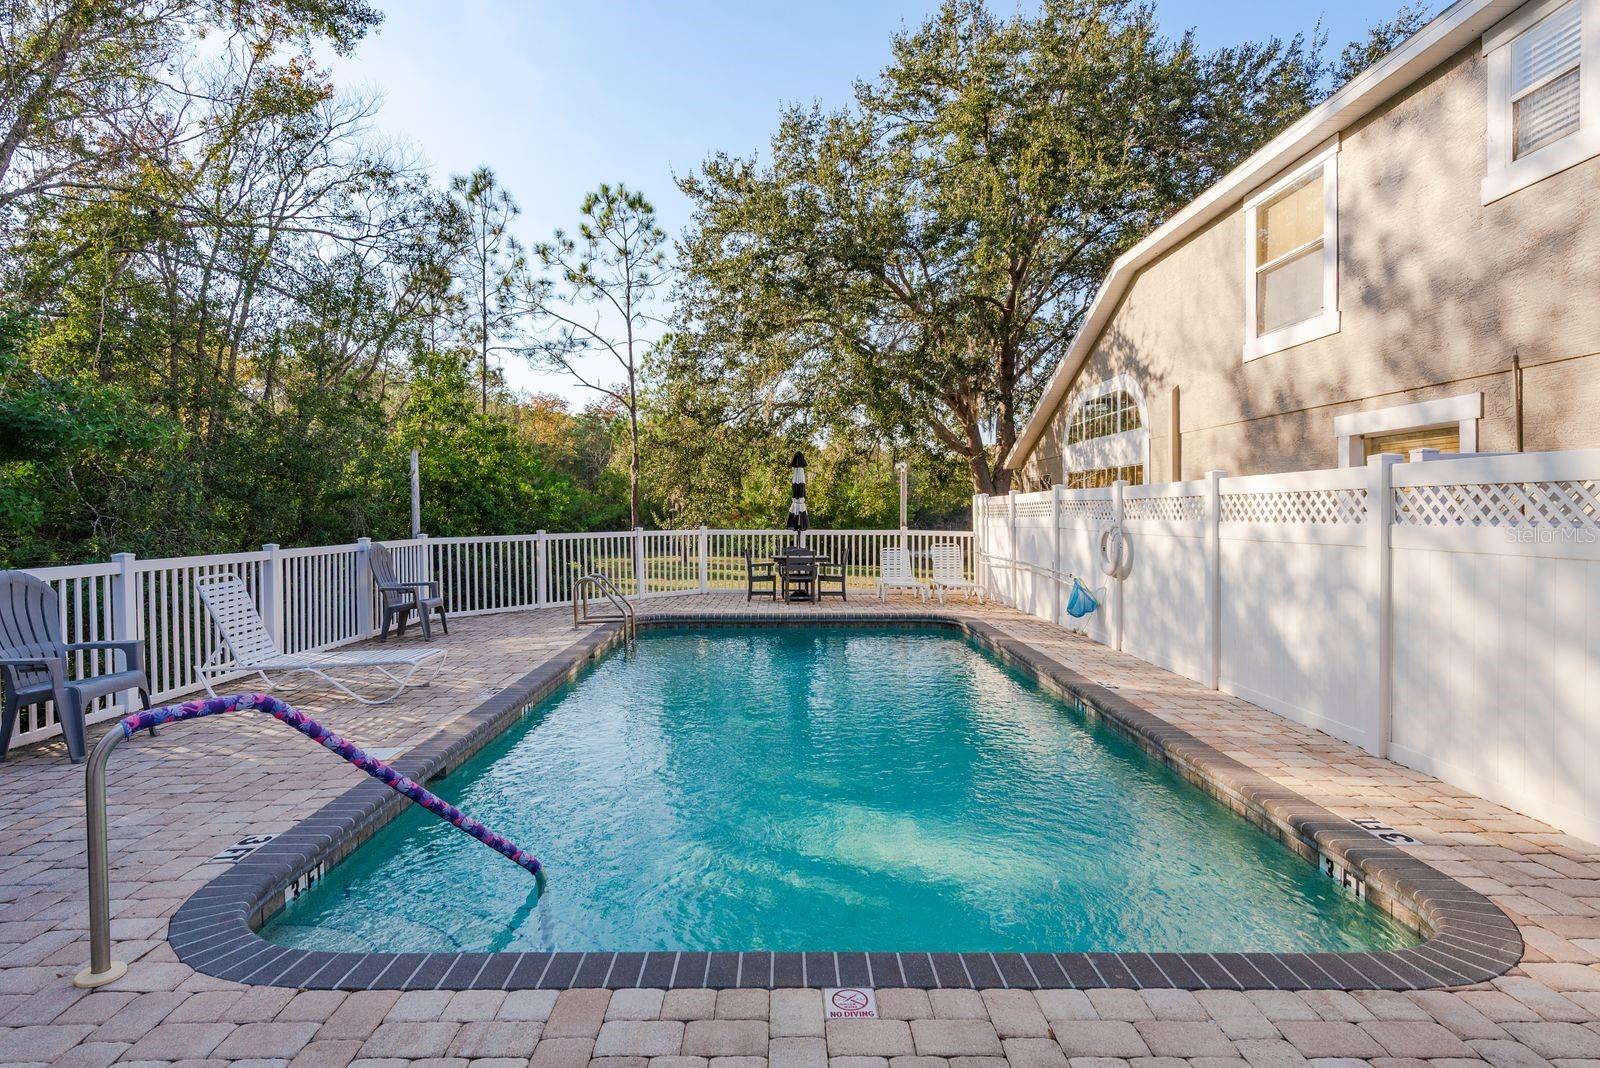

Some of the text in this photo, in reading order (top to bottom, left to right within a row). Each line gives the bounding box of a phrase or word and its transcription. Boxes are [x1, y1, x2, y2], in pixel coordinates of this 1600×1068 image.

[1350, 820, 1414, 842] 3 FT
[208, 836, 273, 862] 3 FT
[1325, 858, 1363, 897] 3 FT
[291, 880, 300, 901] 3
